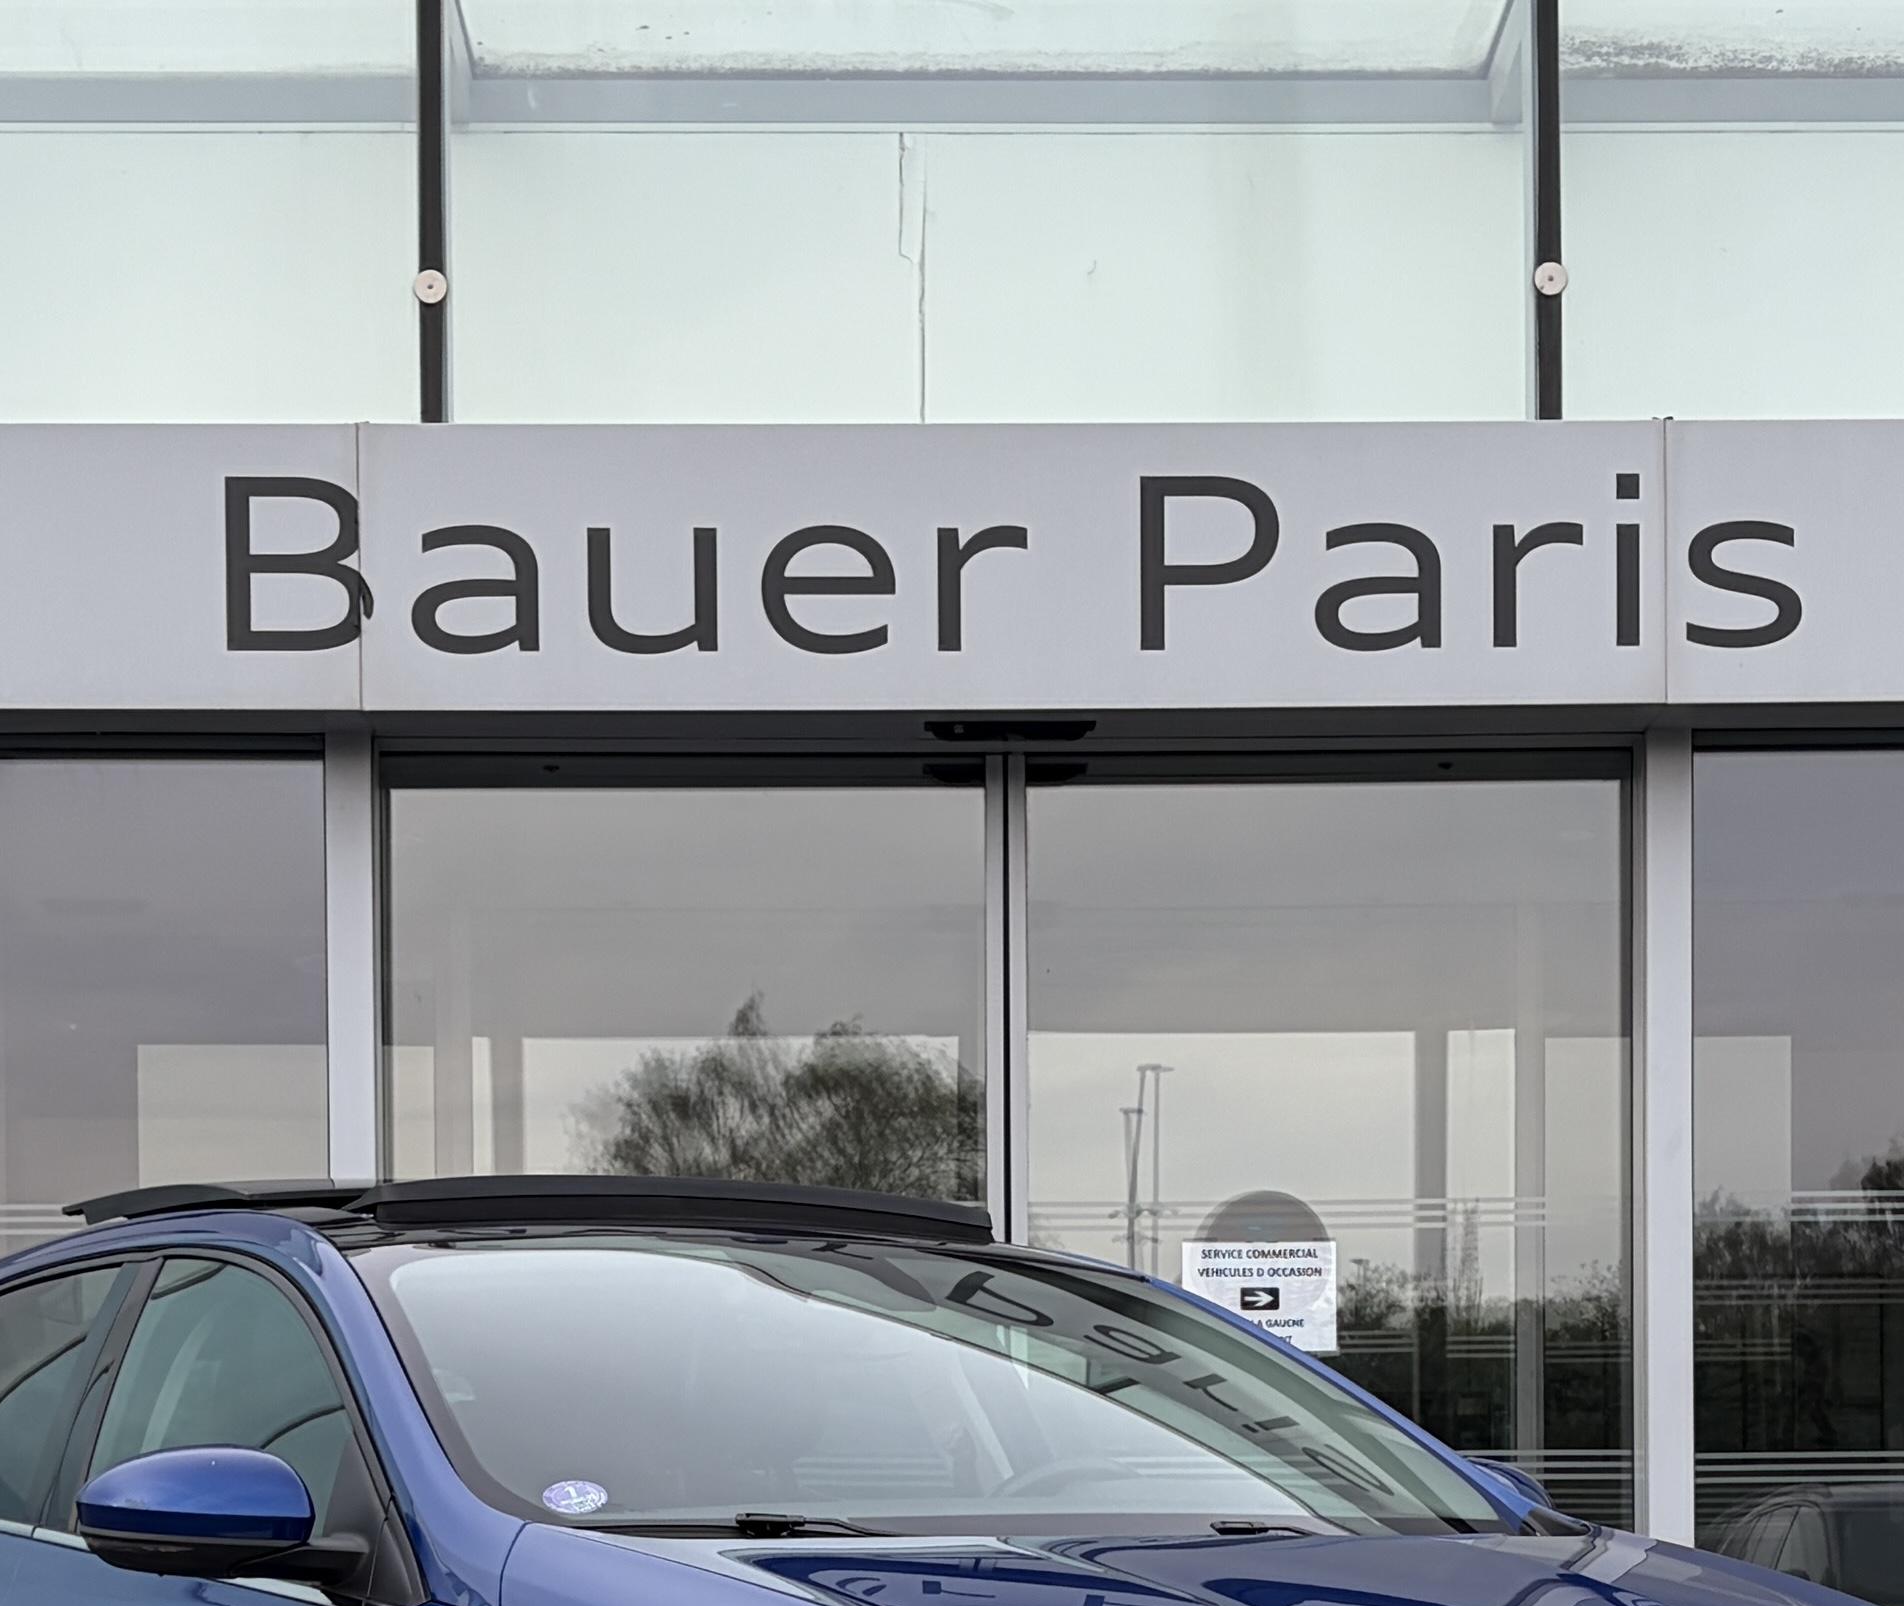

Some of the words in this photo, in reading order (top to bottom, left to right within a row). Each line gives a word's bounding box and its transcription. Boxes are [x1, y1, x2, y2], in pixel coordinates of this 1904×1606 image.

[223, 475, 1029, 656] Bauer
[1138, 473, 1804, 651] Paris
[1201, 1248, 1243, 1260] SERVICE
[1245, 1248, 1319, 1259] COMMERCIAL
